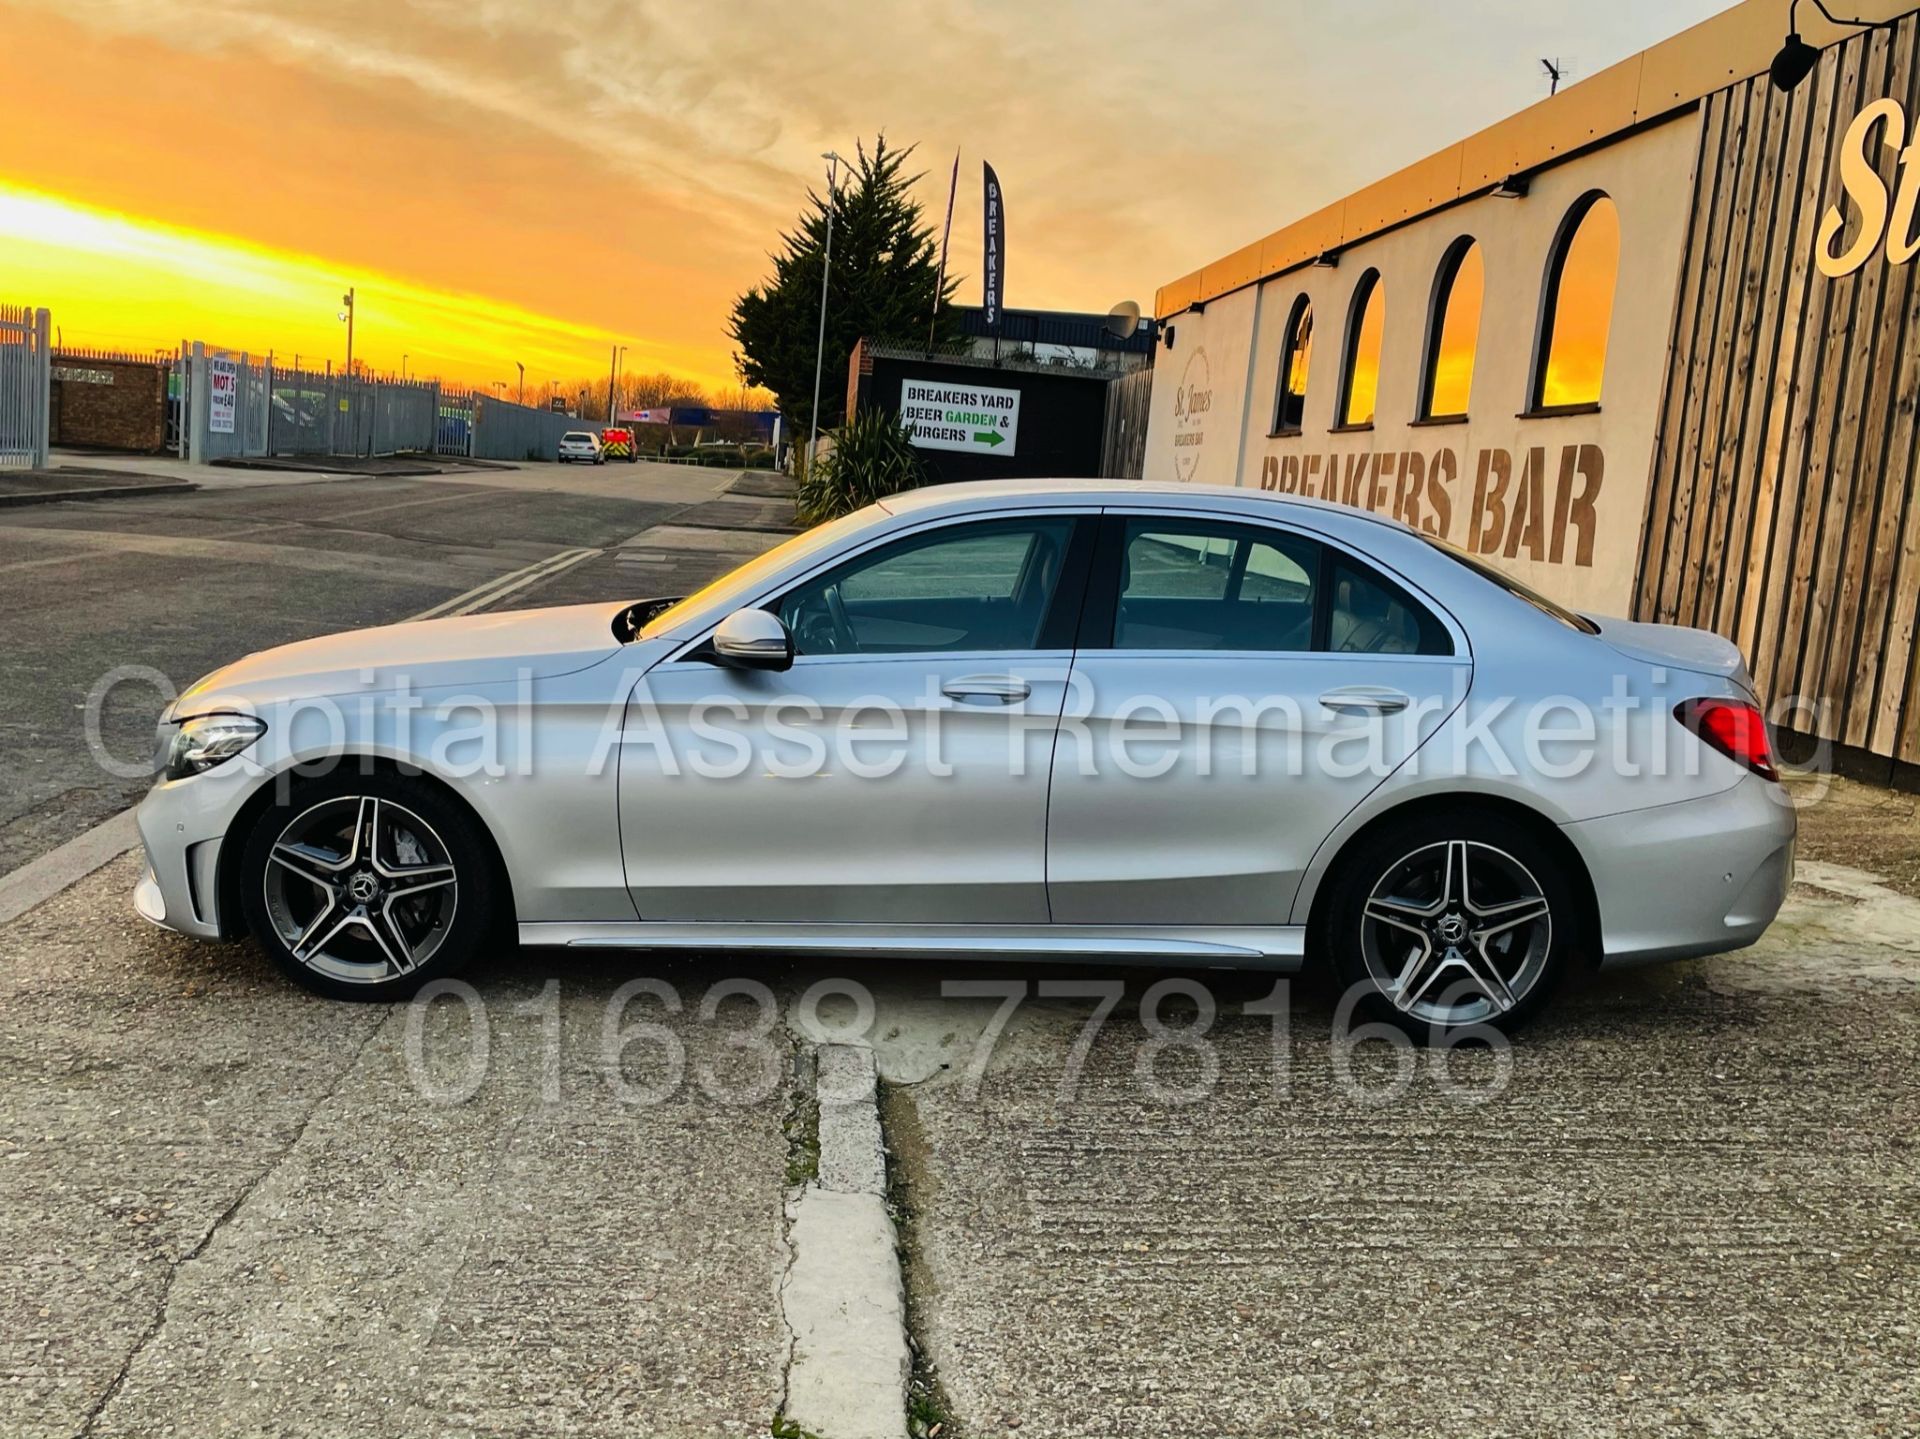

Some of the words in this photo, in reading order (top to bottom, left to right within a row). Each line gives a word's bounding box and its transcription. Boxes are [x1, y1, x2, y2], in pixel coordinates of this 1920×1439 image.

[987, 182, 998, 324] BREAKERS
[214, 374, 229, 391] MOT
[907, 387, 977, 406] BREAKERS
[980, 394, 1014, 410] YARD
[1185, 383, 1213, 423] James
[906, 406, 943, 422] BEER
[945, 410, 998, 427] GARDEN
[999, 415, 1010, 428] &
[1174, 433, 1195, 447] BREAKERS
[1195, 432, 1204, 446] BAR
[1467, 444, 1605, 567] BAR
